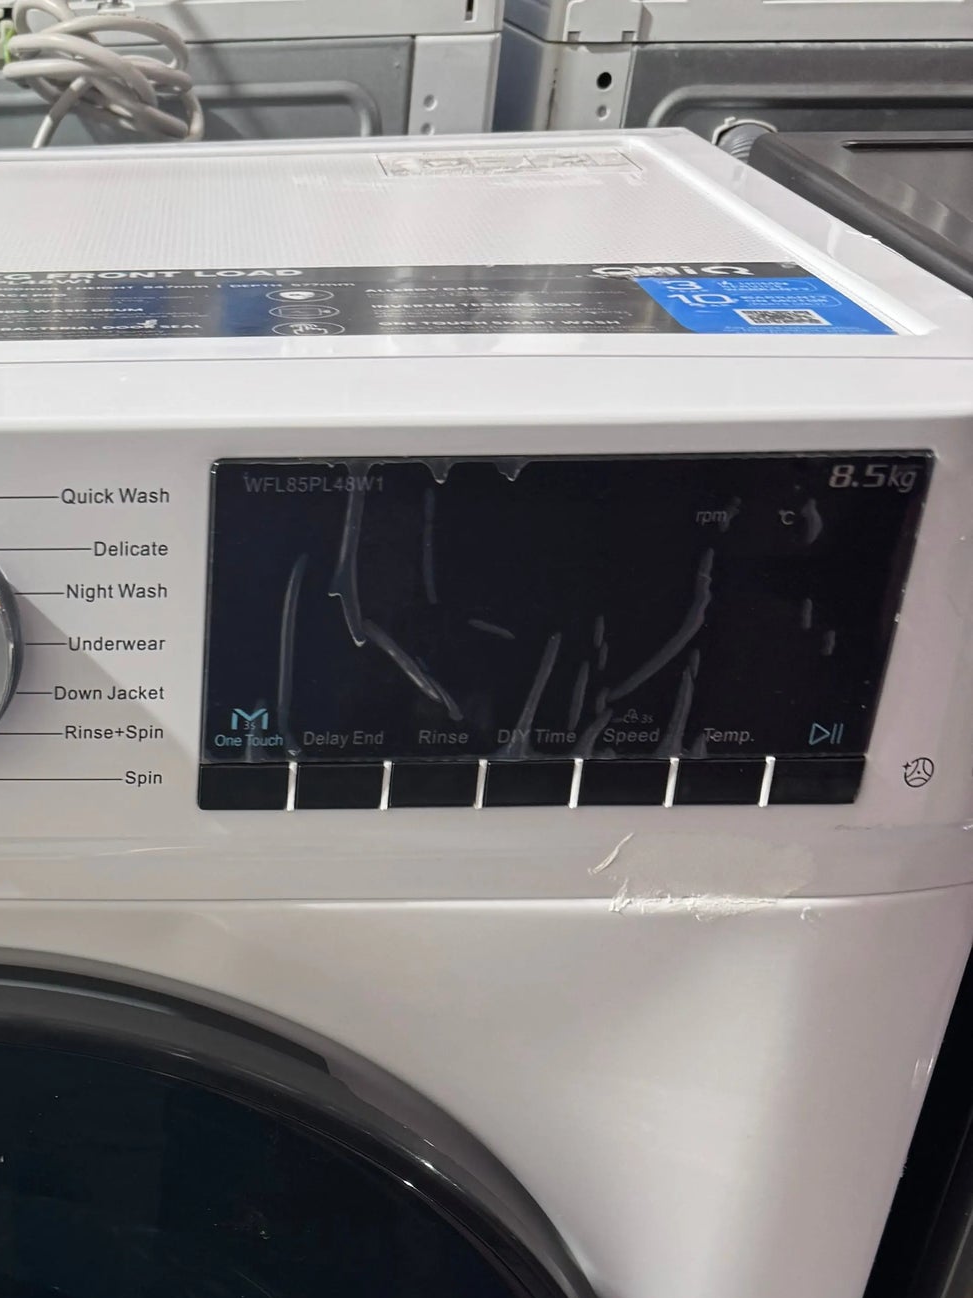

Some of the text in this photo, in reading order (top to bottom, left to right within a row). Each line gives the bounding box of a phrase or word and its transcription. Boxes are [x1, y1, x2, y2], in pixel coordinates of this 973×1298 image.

[46, 271, 182, 279] FRONT
[194, 269, 303, 277] LOAD
[661, 280, 703, 290] 3
[667, 294, 736, 305] 10
[244, 475, 385, 493] WFL85PL48W1
[828, 464, 918, 492] 8.5kg
[60, 487, 170, 507] Quick Wash
[695, 509, 727, 525] rpm
[93, 541, 169, 557] Delicate
[65, 583, 168, 603] Night Wash
[67, 636, 166, 652] Underwear
[54, 685, 165, 701] Down Jacket
[64, 725, 165, 744] Rinse+Spin
[214, 733, 284, 747] One Touch
[303, 730, 384, 750] Delay End
[418, 729, 469, 745] Rinse
[497, 728, 577, 744] DIY Time
[602, 727, 660, 748] Speed
[703, 727, 755, 747] Temp.
[125, 770, 163, 788] Spin
